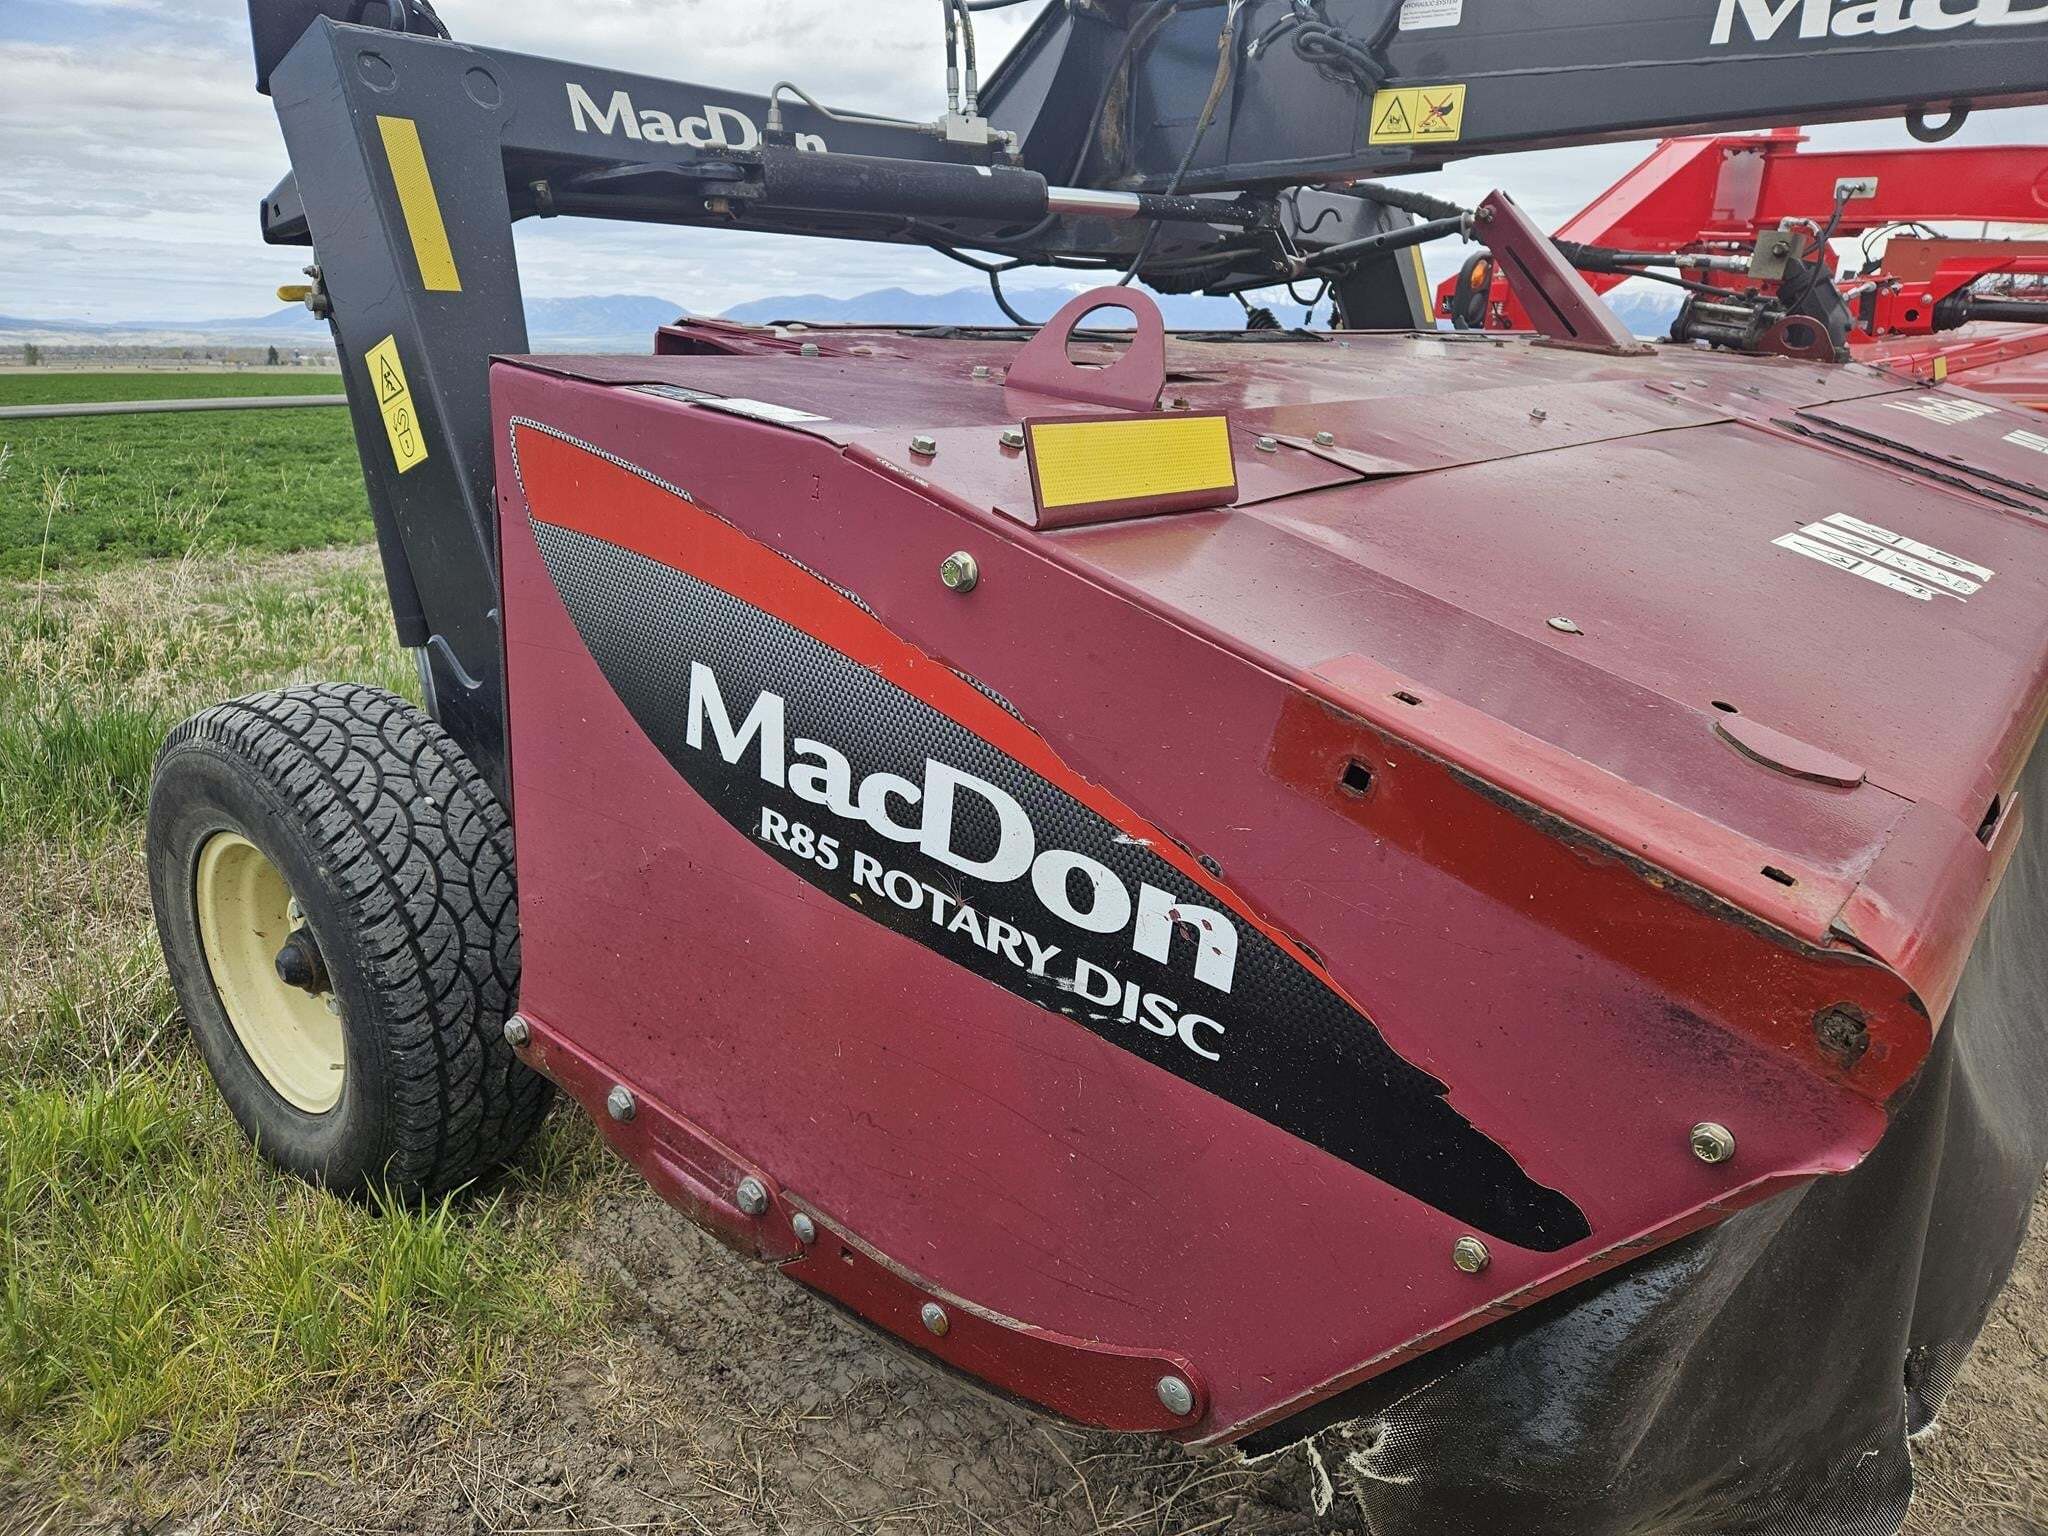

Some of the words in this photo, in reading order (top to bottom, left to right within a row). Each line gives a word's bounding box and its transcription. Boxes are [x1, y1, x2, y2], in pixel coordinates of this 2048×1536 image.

[565, 82, 828, 153] MacDn
[686, 660, 1238, 994] MacDon
[761, 806, 839, 870] R85
[853, 850, 1062, 977] ROTARY
[1073, 957, 1226, 1062] DISC
